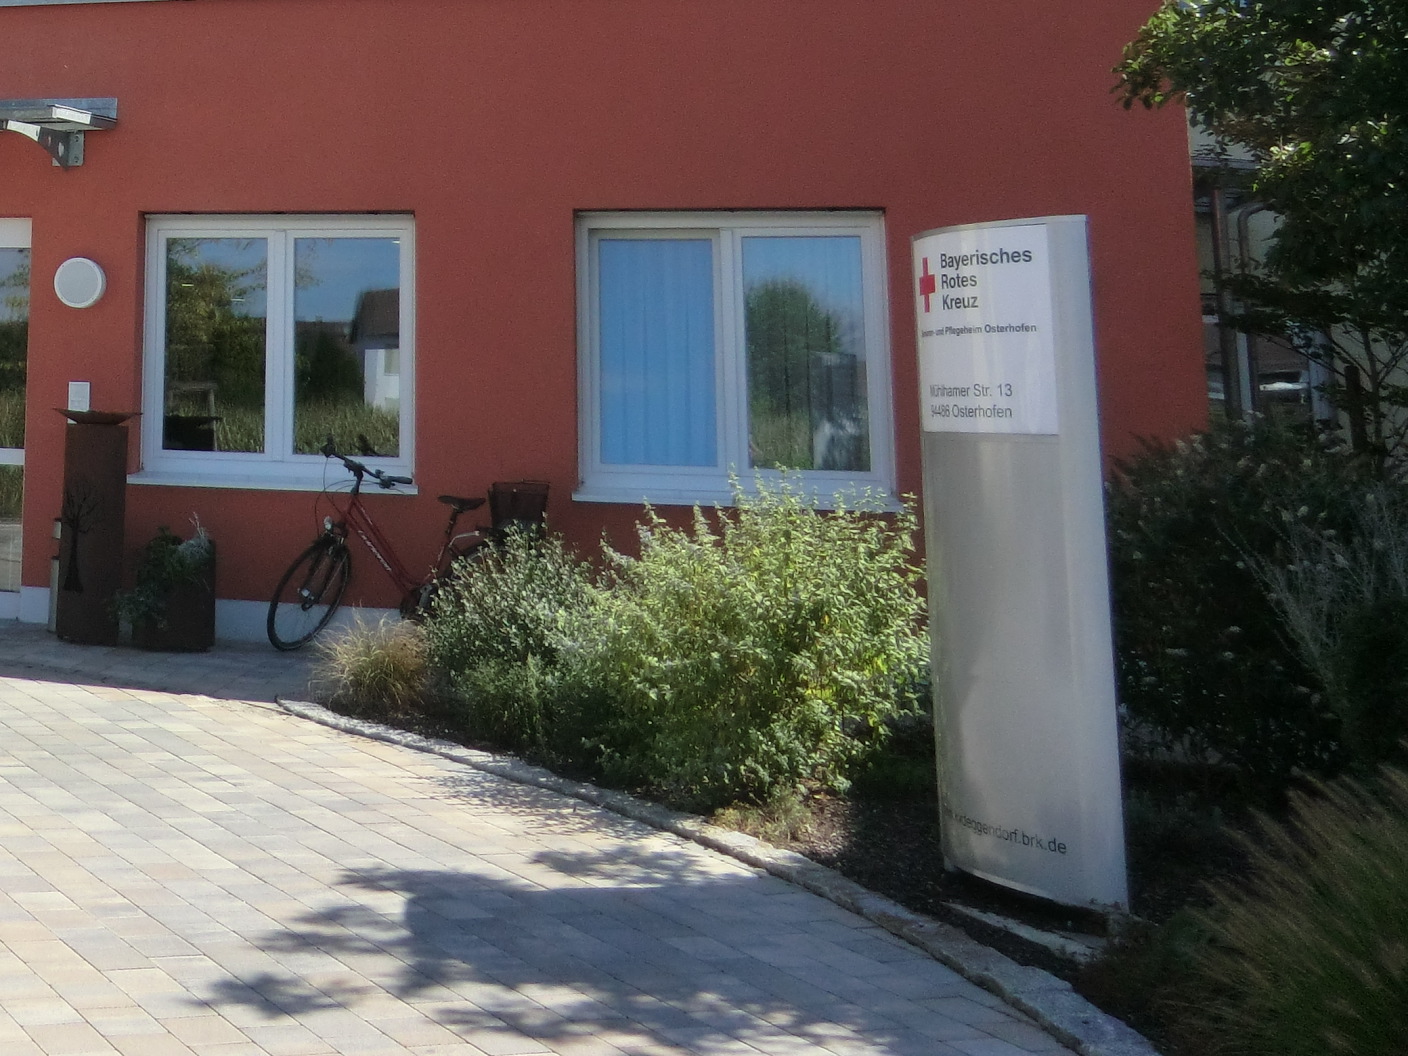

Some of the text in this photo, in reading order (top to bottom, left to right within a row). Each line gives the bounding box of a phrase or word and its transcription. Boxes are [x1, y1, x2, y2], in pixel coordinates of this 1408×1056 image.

[940, 247, 1033, 271] Bayerisches
[941, 273, 978, 290] Rotes
[942, 294, 979, 311] Kreuz
[945, 325, 983, 337] Pflegeheim
[984, 322, 1037, 334] Osterhofen
[973, 383, 993, 398] Str.
[997, 382, 1013, 398] 13
[951, 403, 1013, 419] Osterhofen
